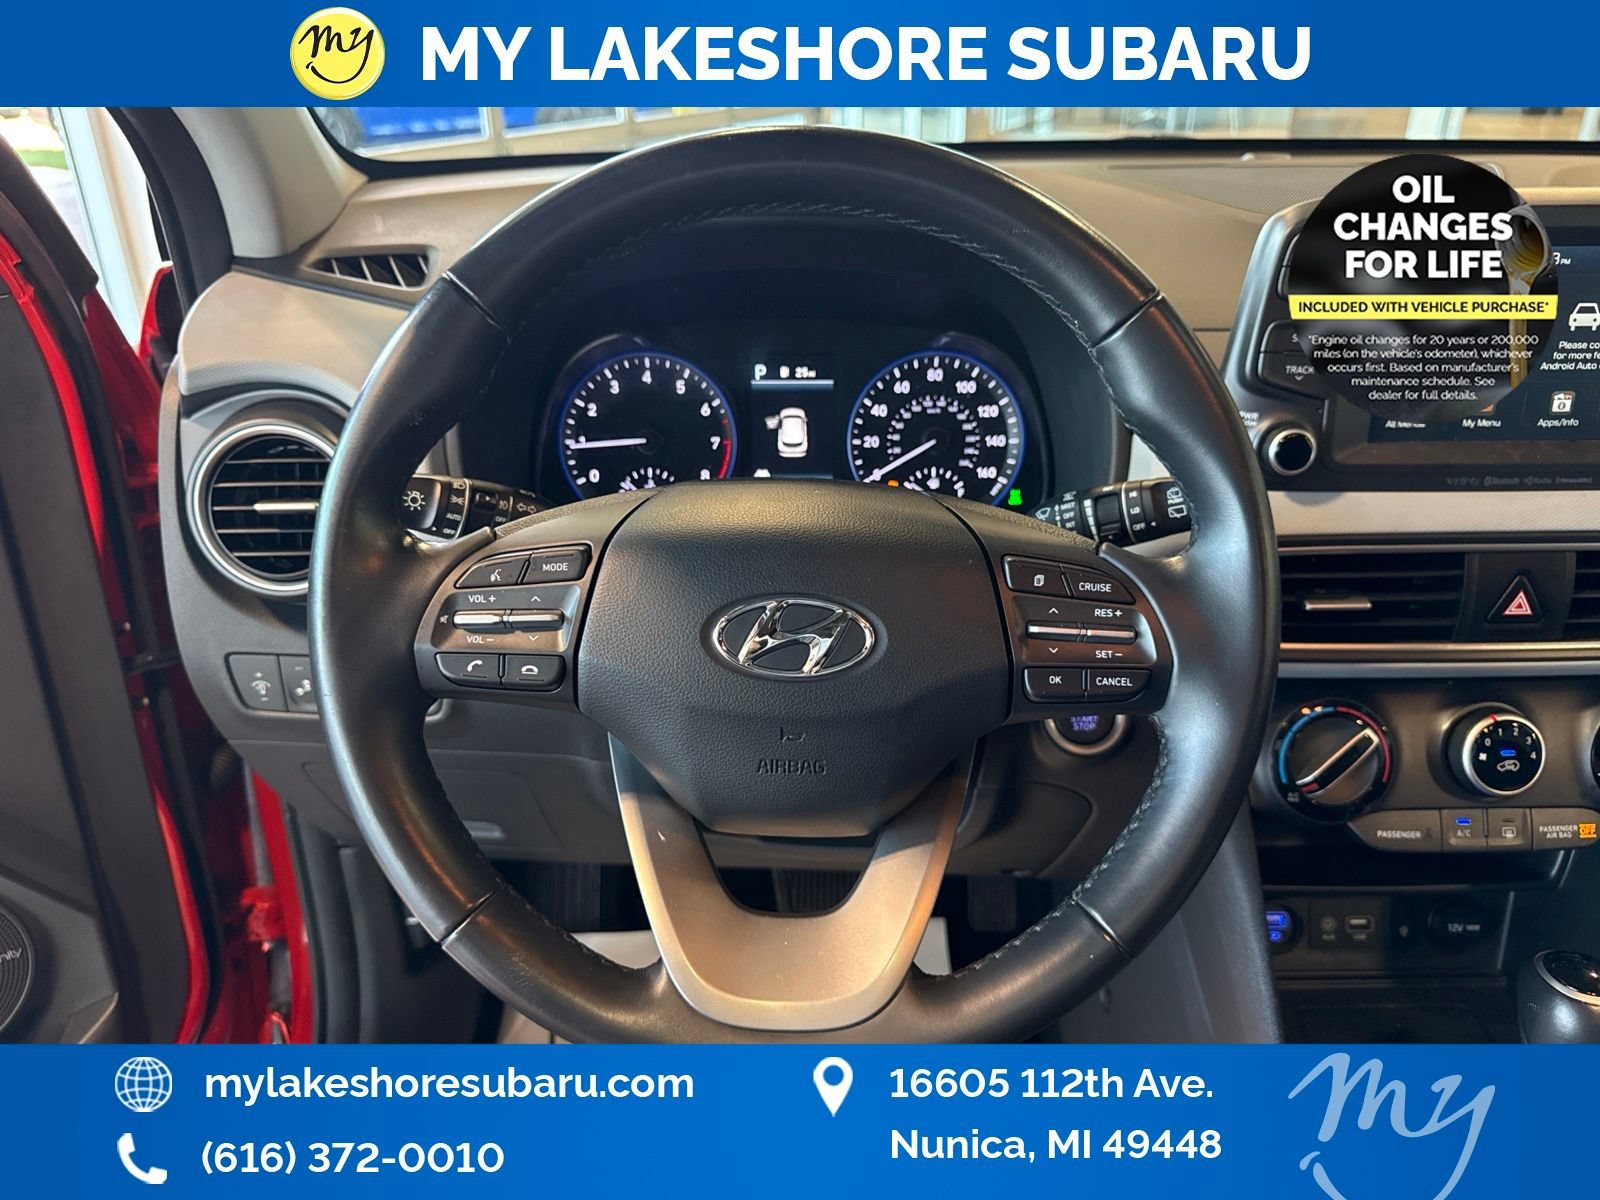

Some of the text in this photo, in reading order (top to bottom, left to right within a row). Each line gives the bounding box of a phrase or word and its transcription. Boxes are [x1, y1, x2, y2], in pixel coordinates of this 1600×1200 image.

[1558, 341, 1588, 350] Please
[1553, 351, 1568, 361] for
[1571, 352, 1592, 360] more
[754, 363, 767, 380] P
[1540, 361, 1596, 371] Android Auto
[641, 370, 653, 384] 4
[926, 368, 944, 382] 80
[609, 379, 620, 394] 3
[675, 379, 687, 394] 5
[893, 380, 911, 394] 60
[955, 380, 977, 394] 100
[586, 402, 598, 417] 2
[700, 402, 711, 417] 6
[870, 404, 888, 417] 40
[976, 405, 999, 418] 120
[1461, 418, 1501, 428] My Menu
[1537, 418, 1580, 429] Apps/Info
[709, 436, 721, 450] 7
[863, 435, 880, 448] 20
[984, 434, 1007, 447] 140
[588, 468, 600, 483] 0
[976, 466, 998, 479] 160
[542, 562, 569, 572] MODE
[1078, 582, 1112, 593] CRUISE
[1049, 675, 1062, 684] OK
[1096, 677, 1133, 687] CANCEL
[1072, 722, 1096, 731] STOP
[1497, 728, 1503, 737] 1
[1513, 728, 1519, 737] 2
[1484, 738, 1491, 747] 0
[1525, 736, 1532, 745] 3
[1530, 751, 1537, 759] 4
[756, 759, 827, 775] AIRBAG
[1456, 829, 1472, 838] A/C
[1539, 824, 1578, 833] PASSENGER
[1579, 825, 1596, 836] OFF
[1377, 830, 1422, 839] PASSENGER
